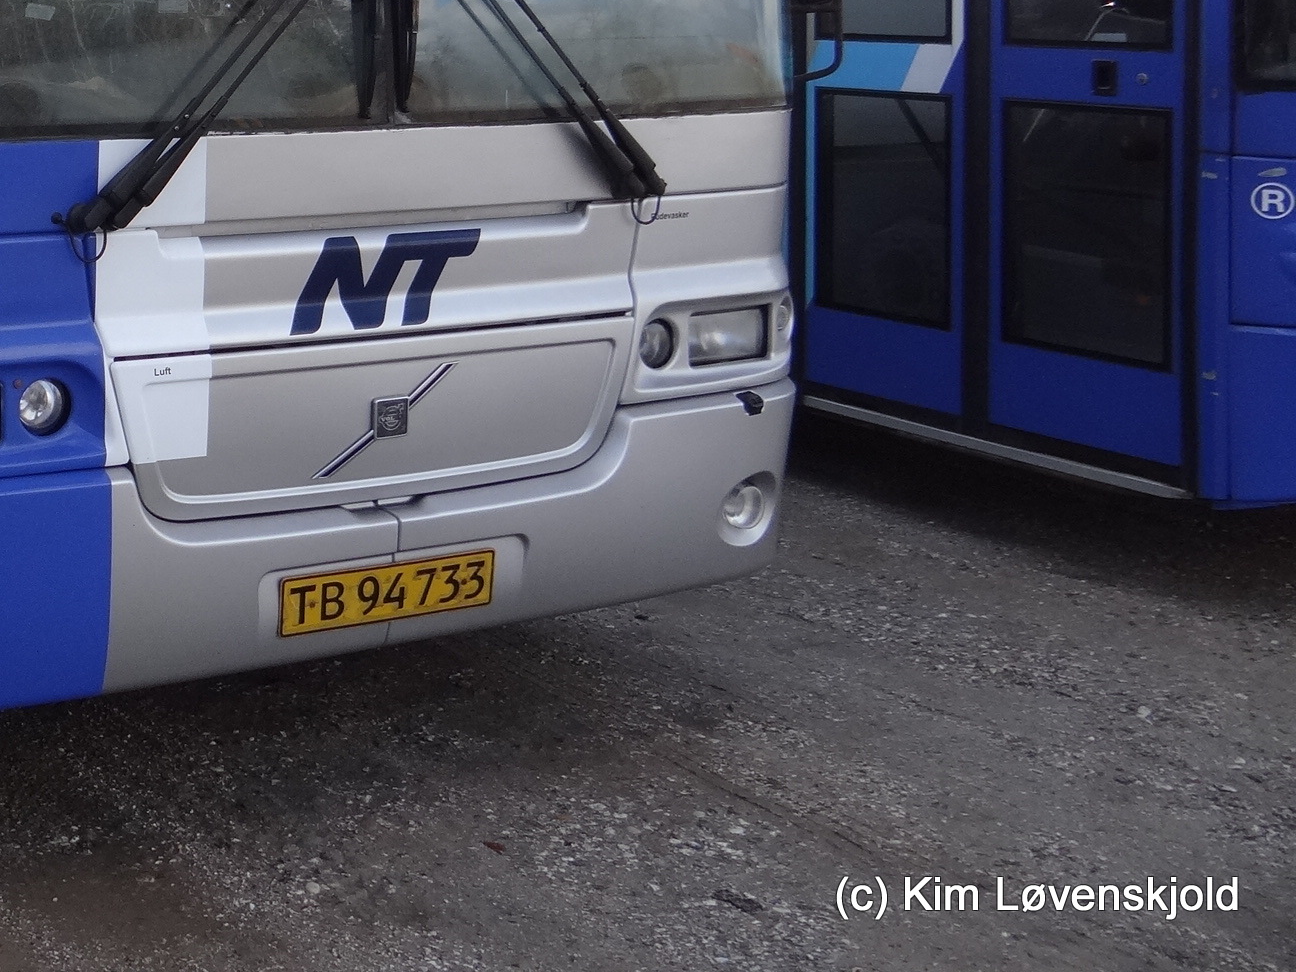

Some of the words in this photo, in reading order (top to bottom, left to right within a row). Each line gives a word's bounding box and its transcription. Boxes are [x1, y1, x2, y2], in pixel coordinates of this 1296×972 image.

[1261, 189, 1285, 213] R
[289, 228, 481, 336] NT
[154, 367, 171, 376] Luft
[290, 581, 345, 625] TB
[357, 572, 406, 616] 94
[416, 560, 486, 606] 733
